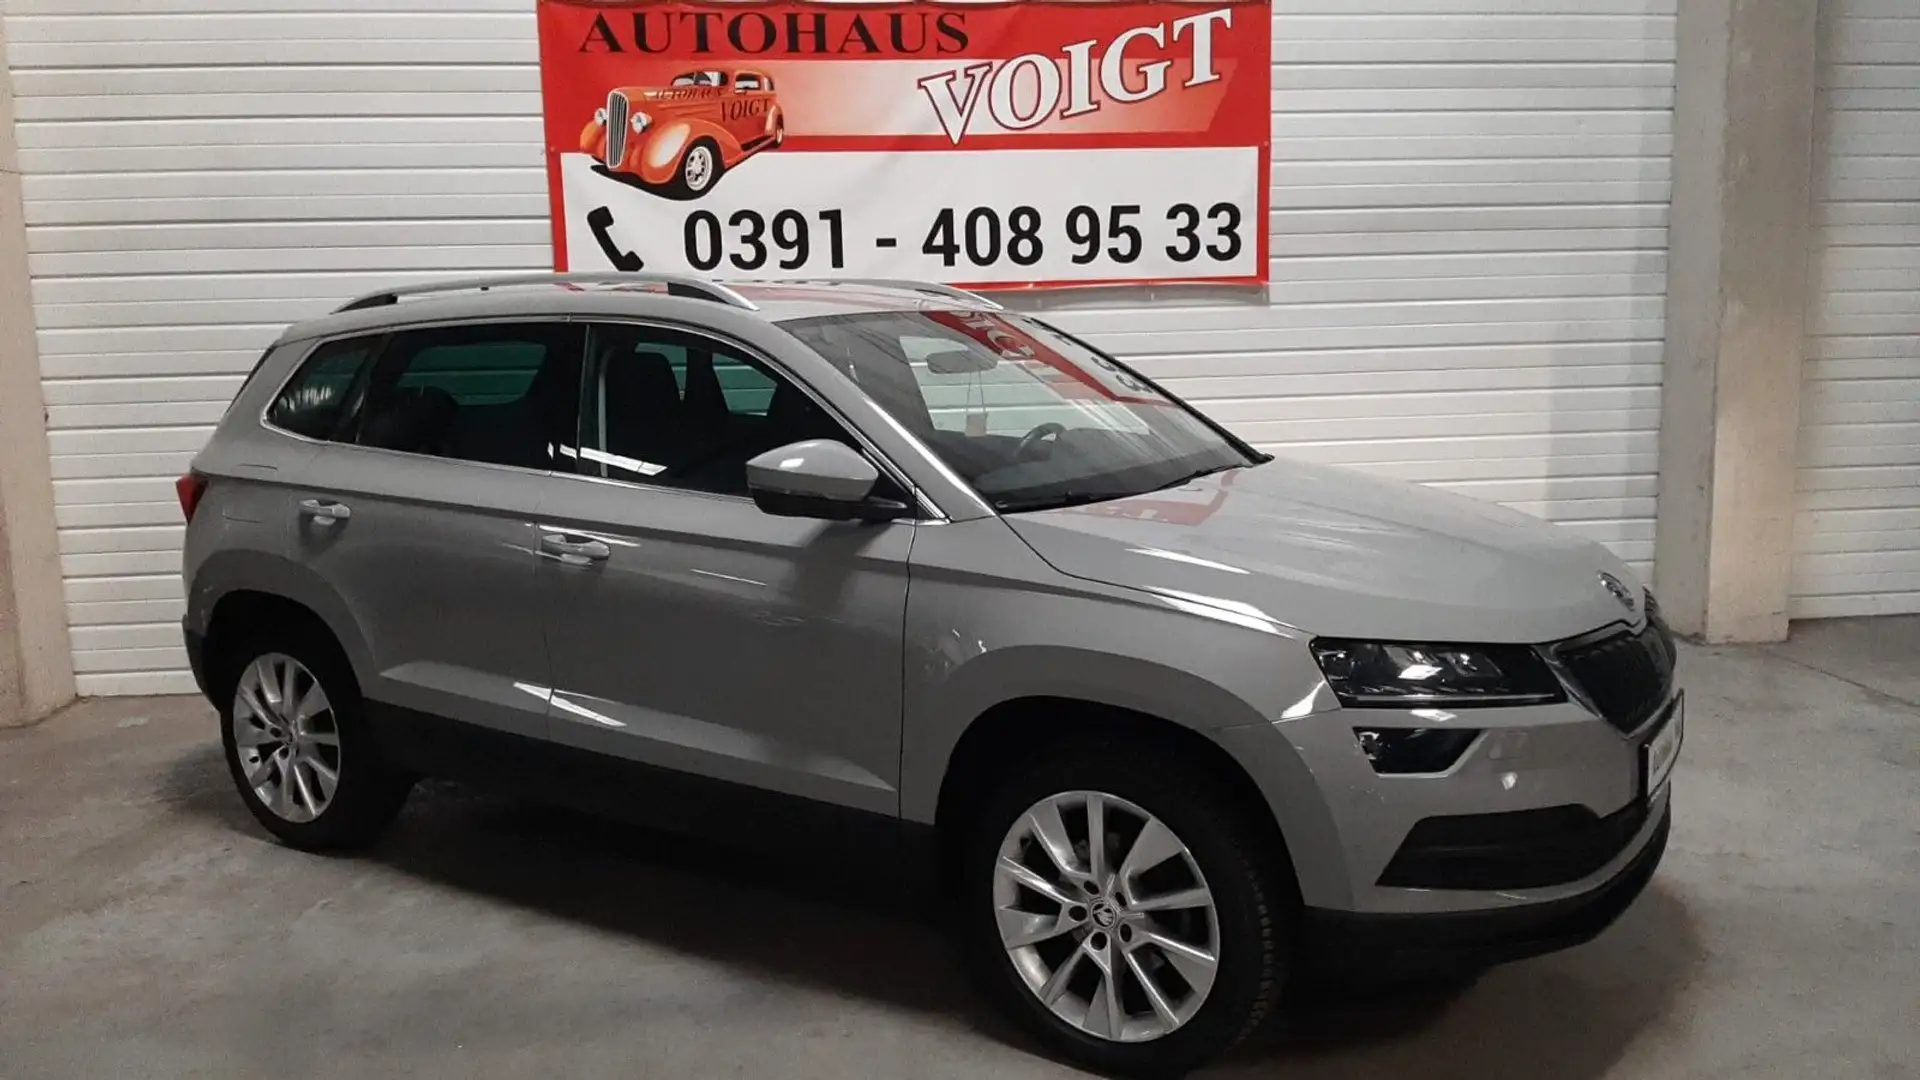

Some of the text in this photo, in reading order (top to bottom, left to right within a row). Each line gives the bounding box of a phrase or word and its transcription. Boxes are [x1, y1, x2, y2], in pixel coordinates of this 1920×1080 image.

[578, 12, 969, 54] AUTOHAUS
[917, 8, 1232, 145] VOIGT
[720, 98, 771, 122] VOIGT
[684, 209, 844, 271] 0391
[922, 206, 1043, 267] 408
[1065, 205, 1142, 265] 95
[1165, 202, 1242, 262] 33
